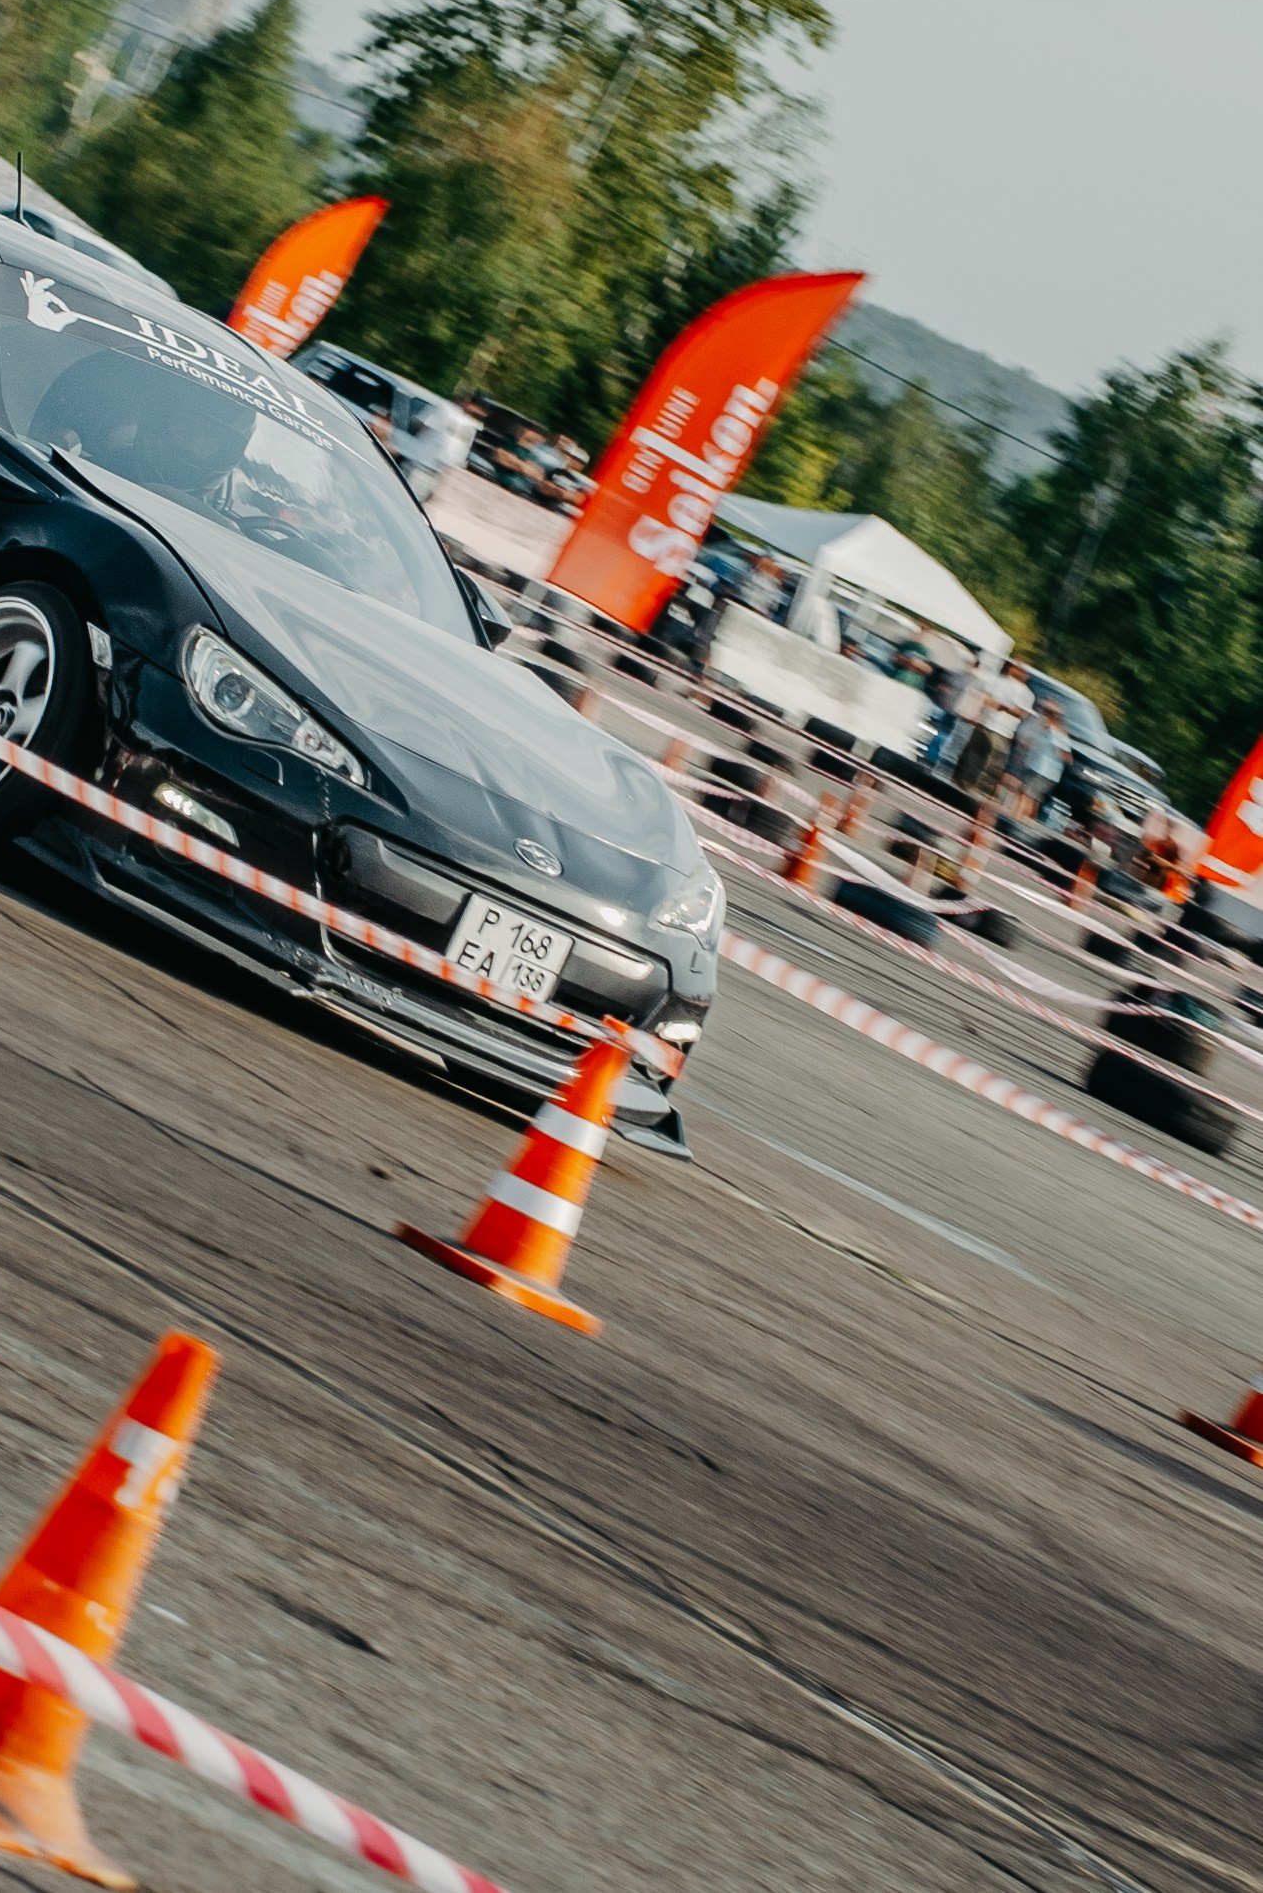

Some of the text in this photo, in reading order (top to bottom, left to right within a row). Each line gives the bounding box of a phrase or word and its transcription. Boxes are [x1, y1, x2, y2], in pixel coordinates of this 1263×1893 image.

[132, 314, 324, 427] IDEAL
[147, 346, 334, 451] Perfomance Garage
[511, 923, 553, 960] 168
[513, 963, 545, 992] 138
